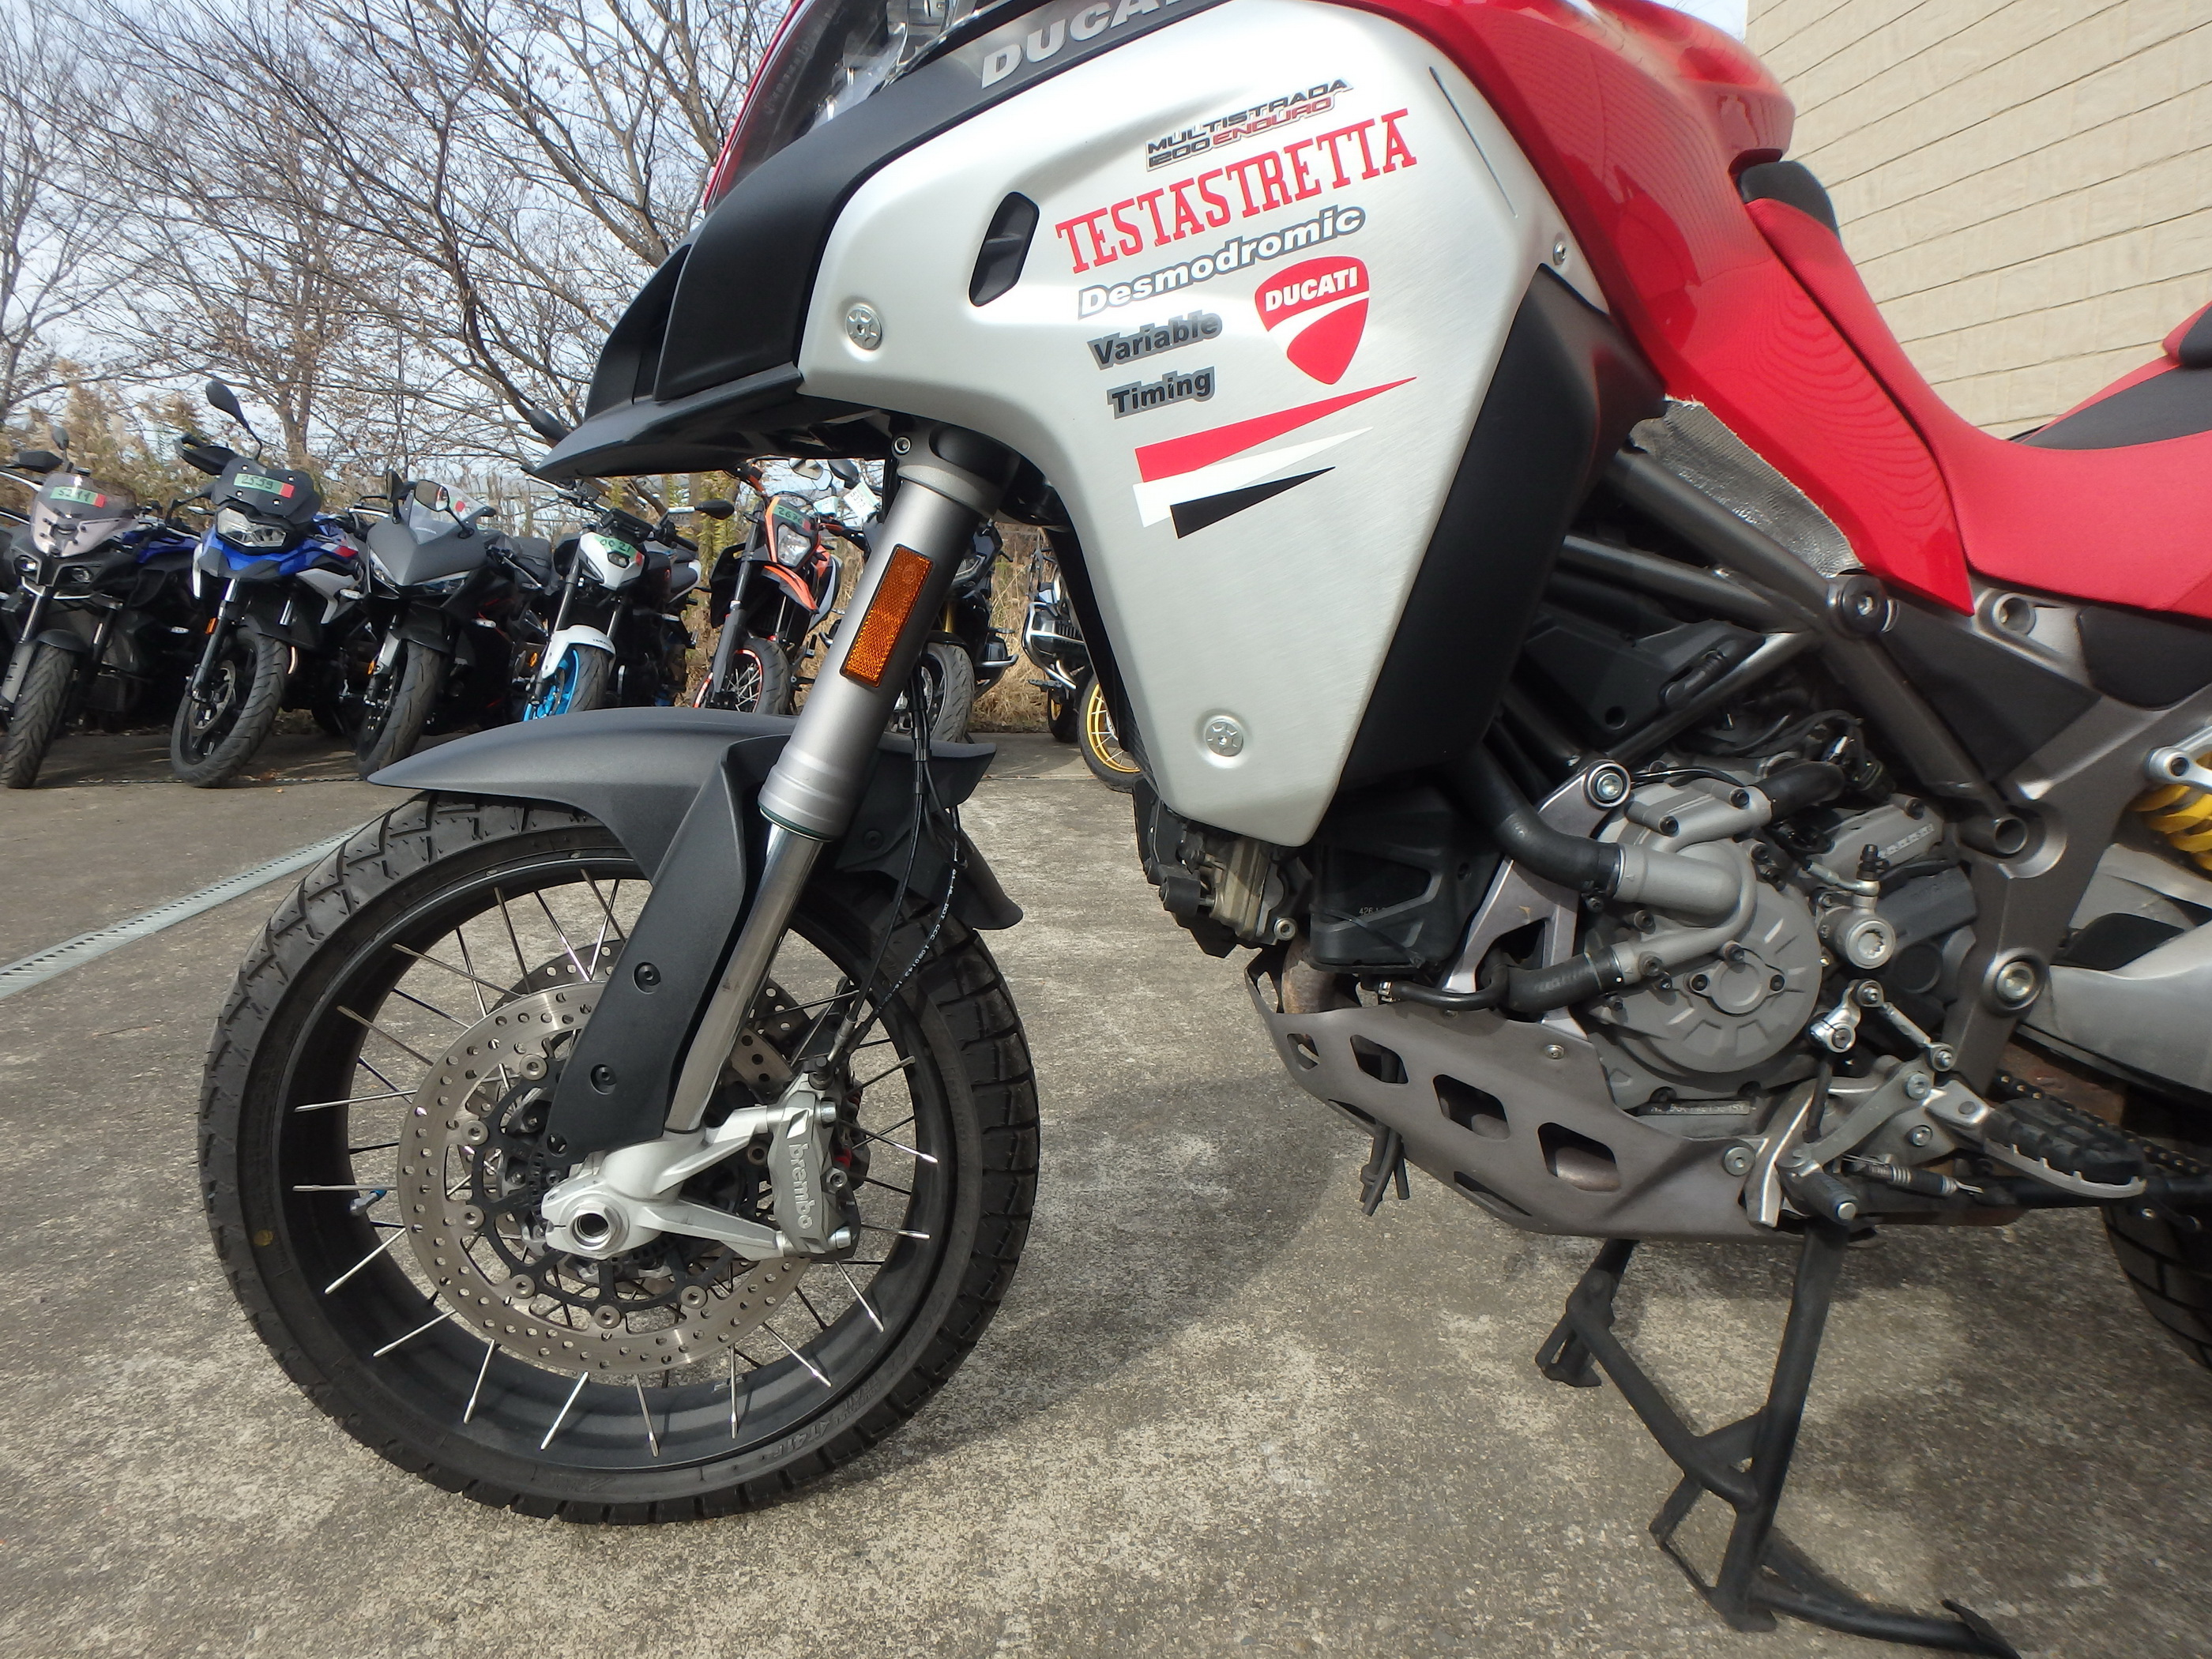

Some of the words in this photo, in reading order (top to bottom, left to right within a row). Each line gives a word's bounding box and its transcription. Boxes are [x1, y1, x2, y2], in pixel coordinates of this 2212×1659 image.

[981, 0, 1183, 89] DUCA
[1147, 78, 1348, 154] MULTISTRADA
[1213, 96, 1332, 145] ENDURO
[1055, 108, 1417, 273] TESTASTRETTA
[1079, 206, 1364, 318] Desmodromic
[1266, 267, 1359, 311] DUCATI
[1092, 313, 1221, 366] Variable
[1111, 371, 1211, 415] Timing
[788, 1143, 817, 1229] brembo
